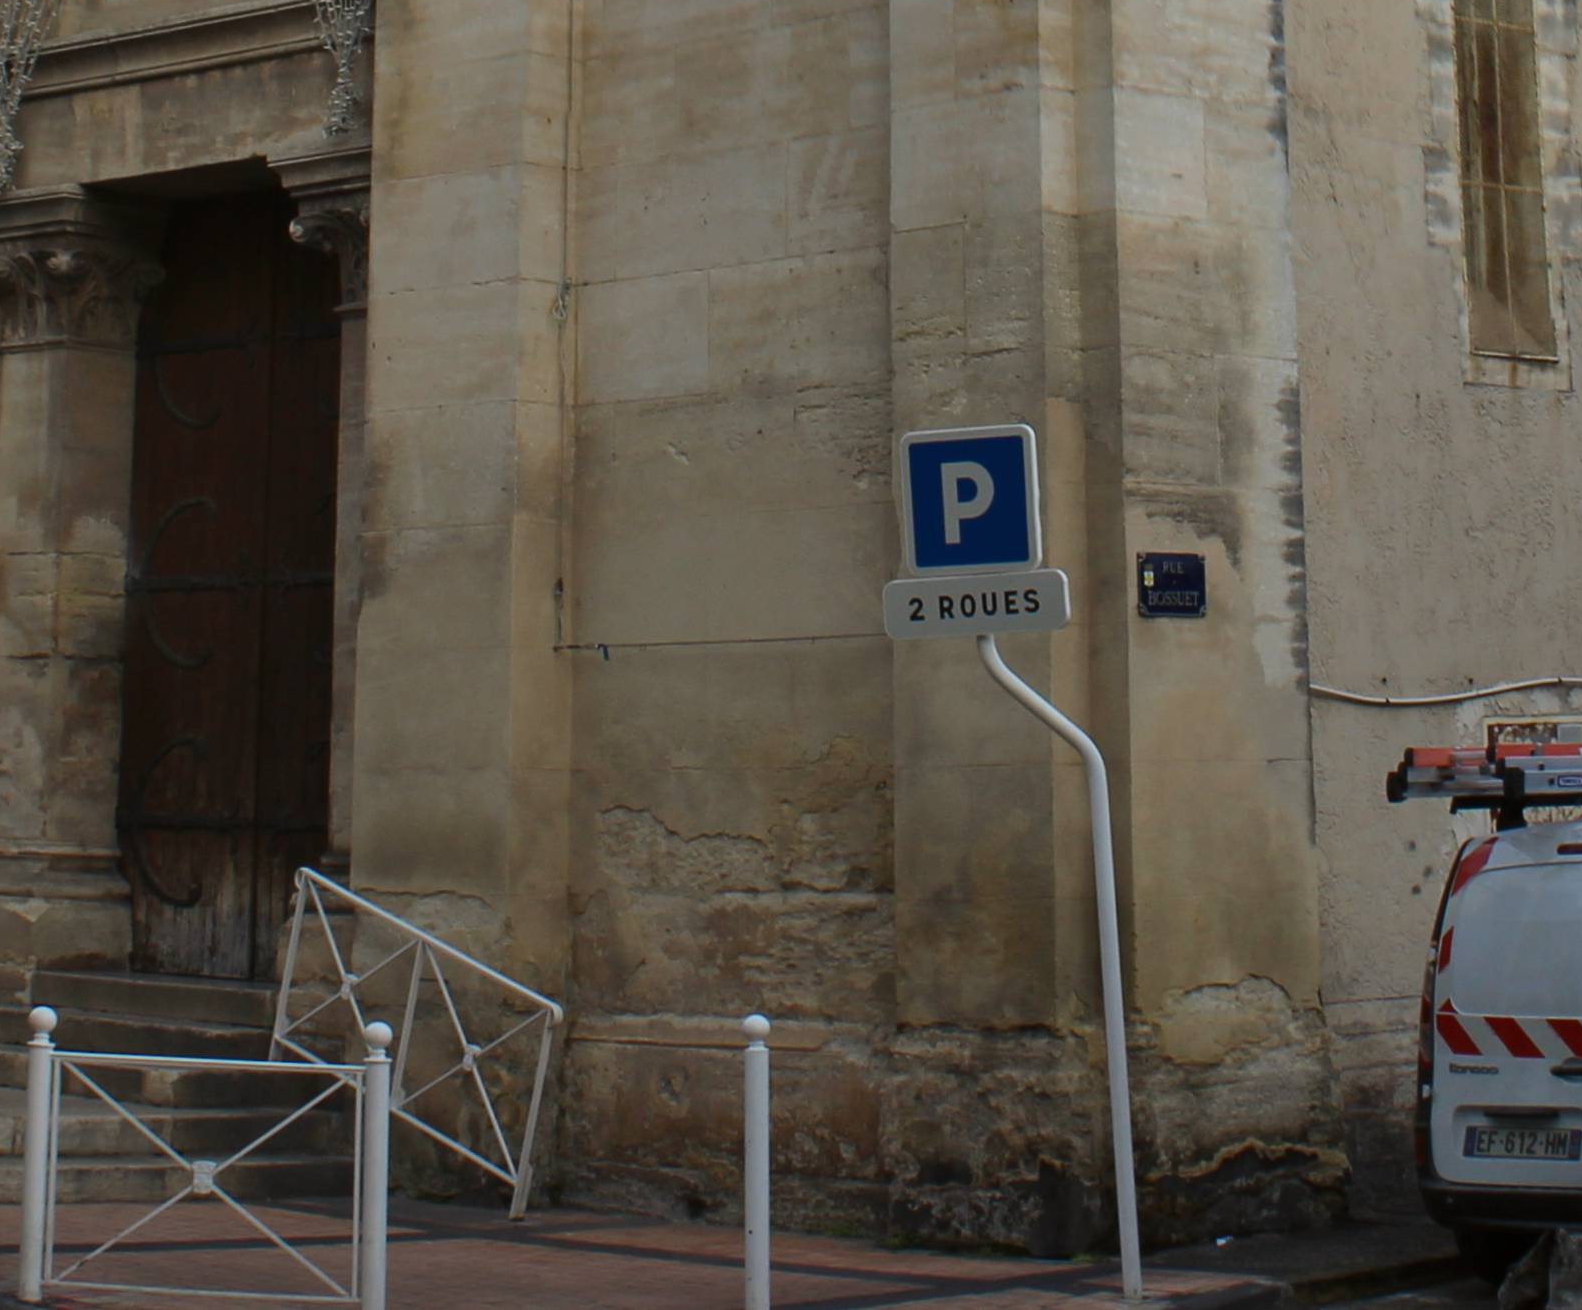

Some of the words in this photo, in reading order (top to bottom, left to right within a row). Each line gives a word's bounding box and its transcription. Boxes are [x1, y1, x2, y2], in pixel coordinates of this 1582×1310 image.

[940, 461, 995, 544] P
[1161, 561, 1185, 575] RUE
[908, 597, 926, 622] 2
[938, 588, 1041, 620] ROUES
[1147, 591, 1200, 607] BOSSUET
